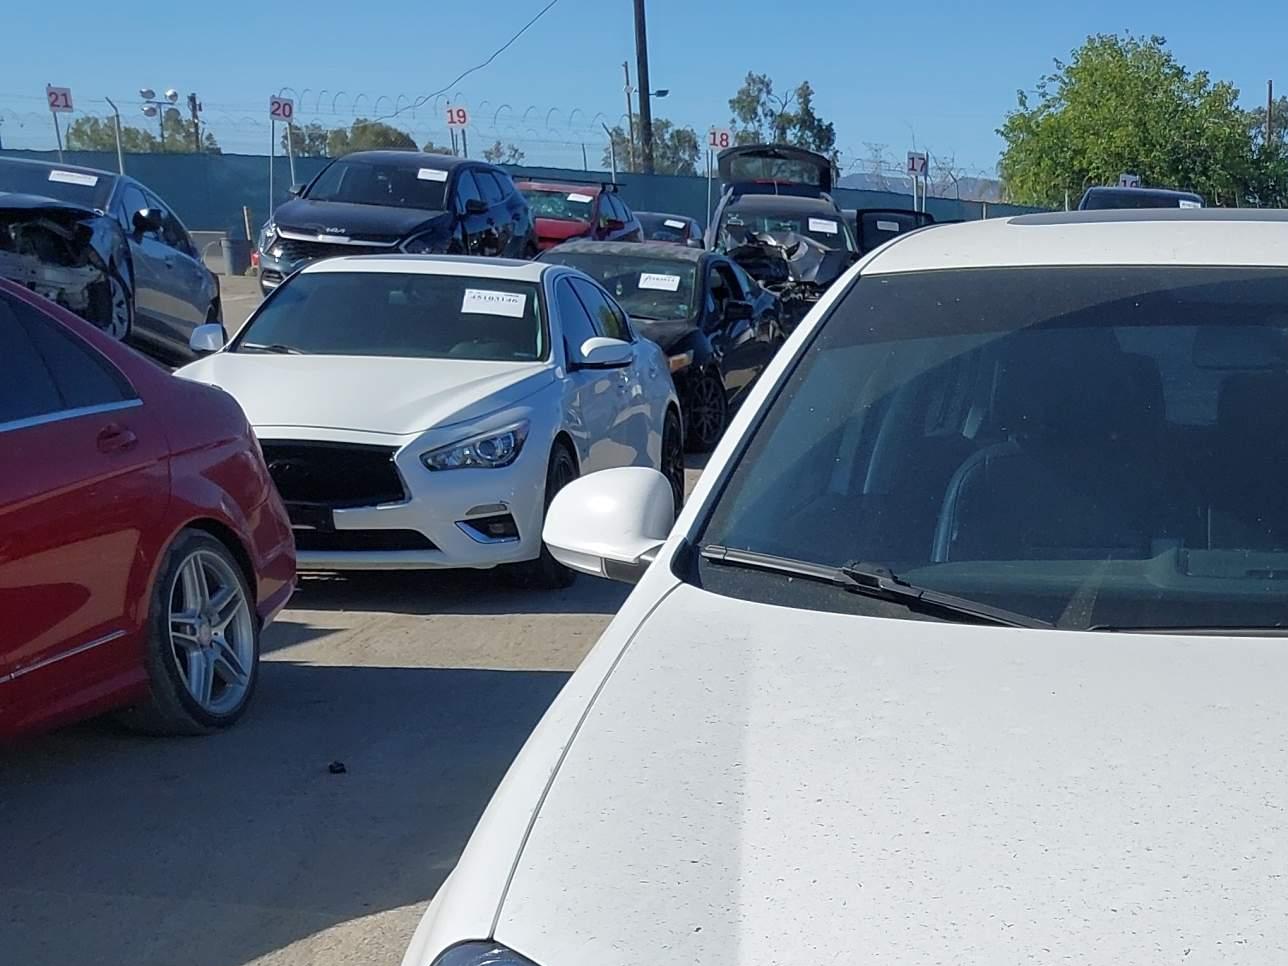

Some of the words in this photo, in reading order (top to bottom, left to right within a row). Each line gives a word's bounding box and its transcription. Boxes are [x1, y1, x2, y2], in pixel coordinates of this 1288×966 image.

[48, 91, 73, 109] 21
[270, 101, 292, 118] 20
[447, 109, 466, 125] 19
[710, 132, 729, 148] 18
[909, 157, 926, 172] 17
